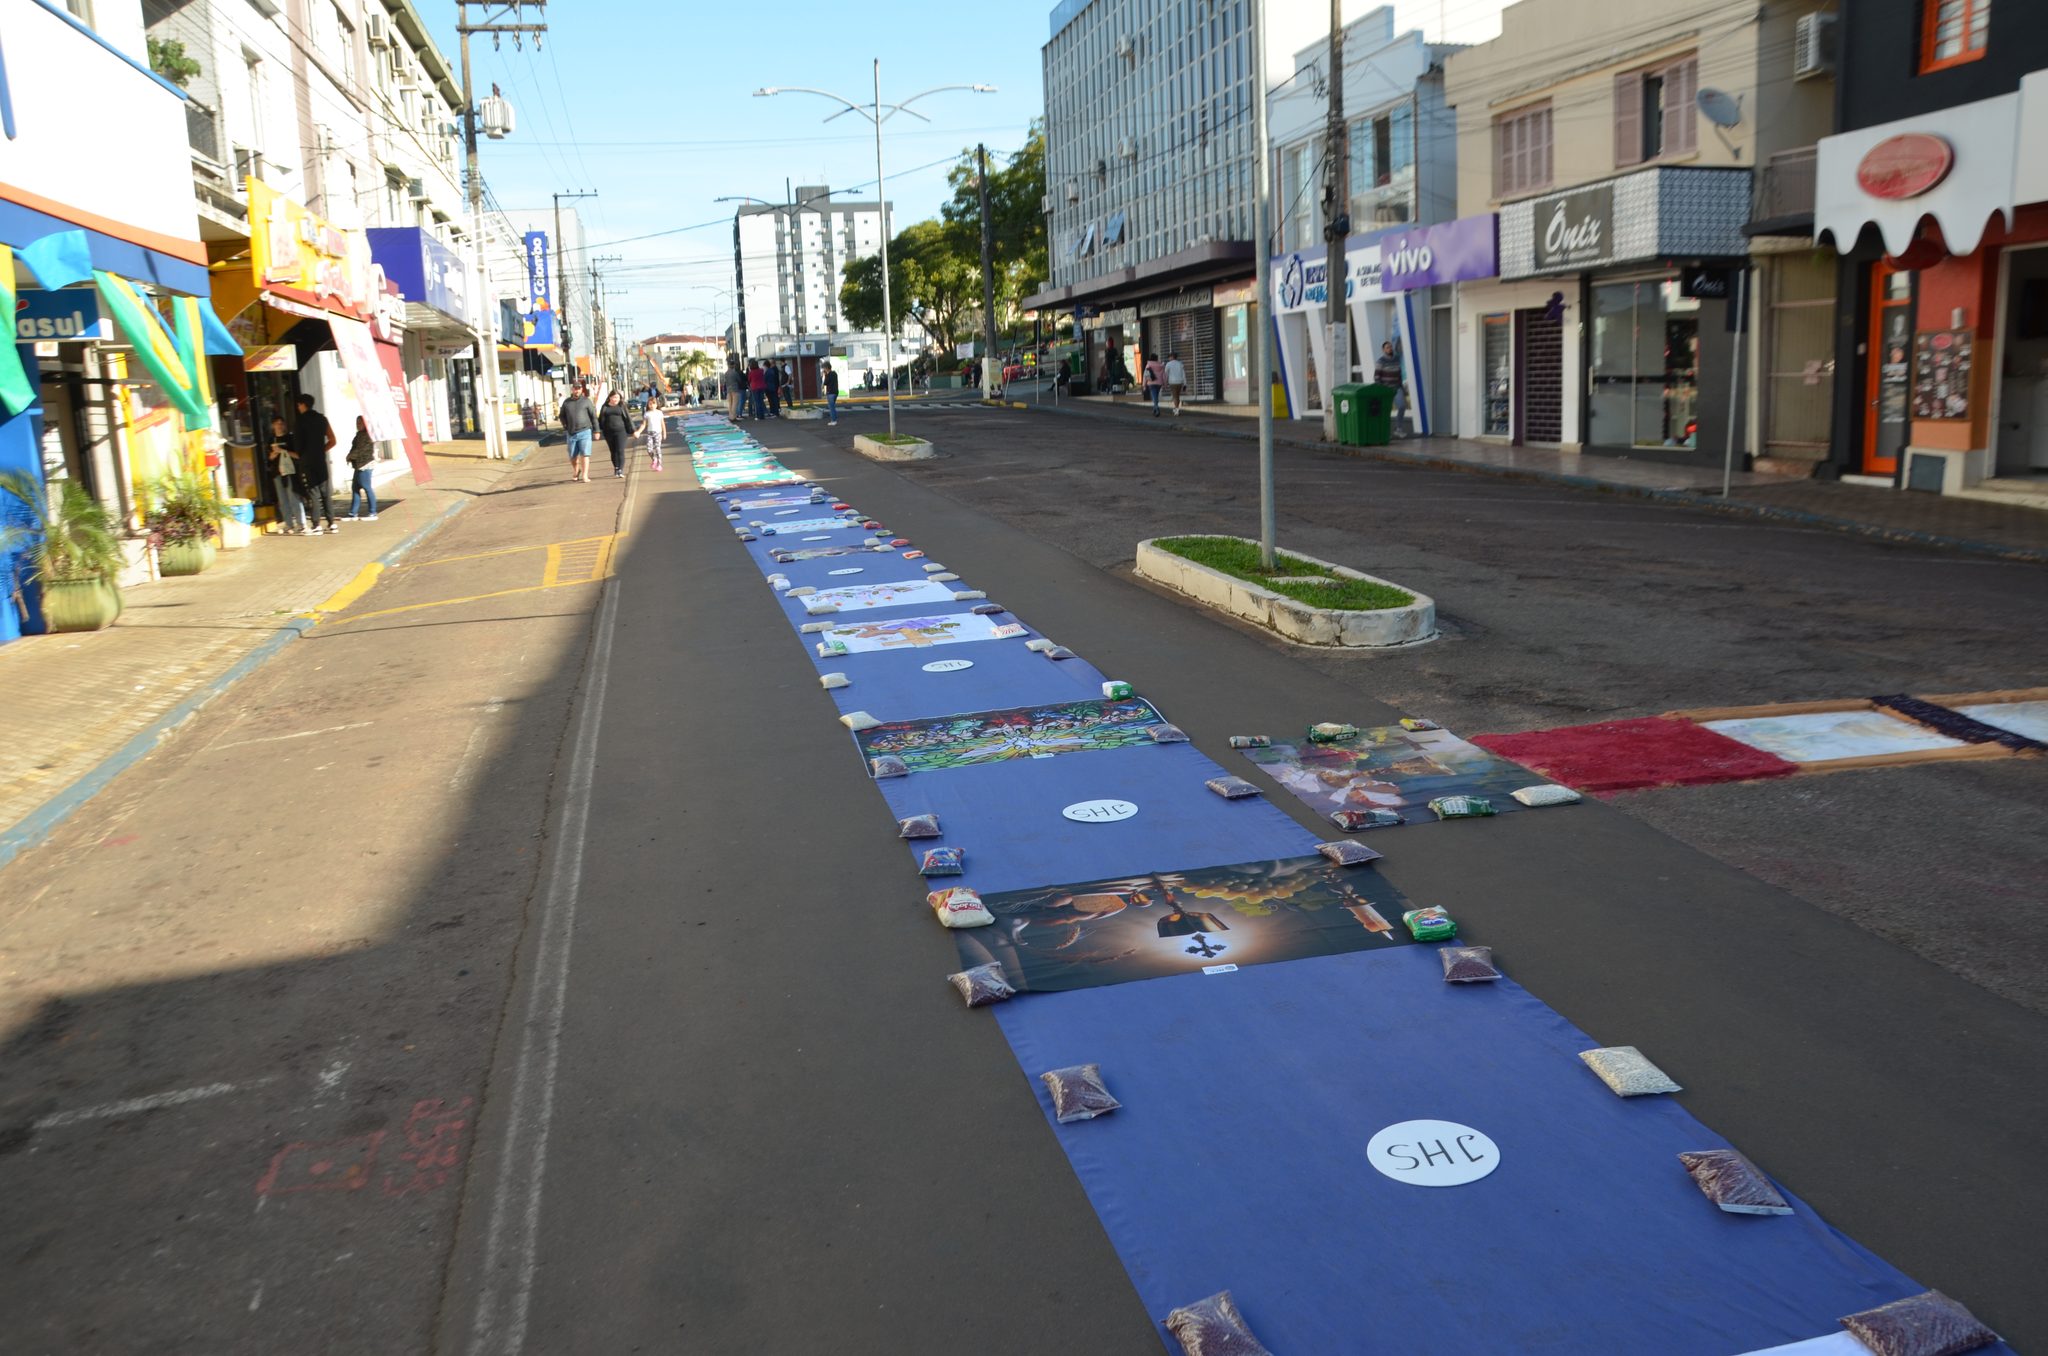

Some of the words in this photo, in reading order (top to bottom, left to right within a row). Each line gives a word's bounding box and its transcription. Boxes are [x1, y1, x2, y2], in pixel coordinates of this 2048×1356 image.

[1545, 200, 1601, 253] Ônix
[532, 237, 546, 296] Colombo
[1389, 240, 1433, 276] vivo
[17, 310, 84, 337] asul
